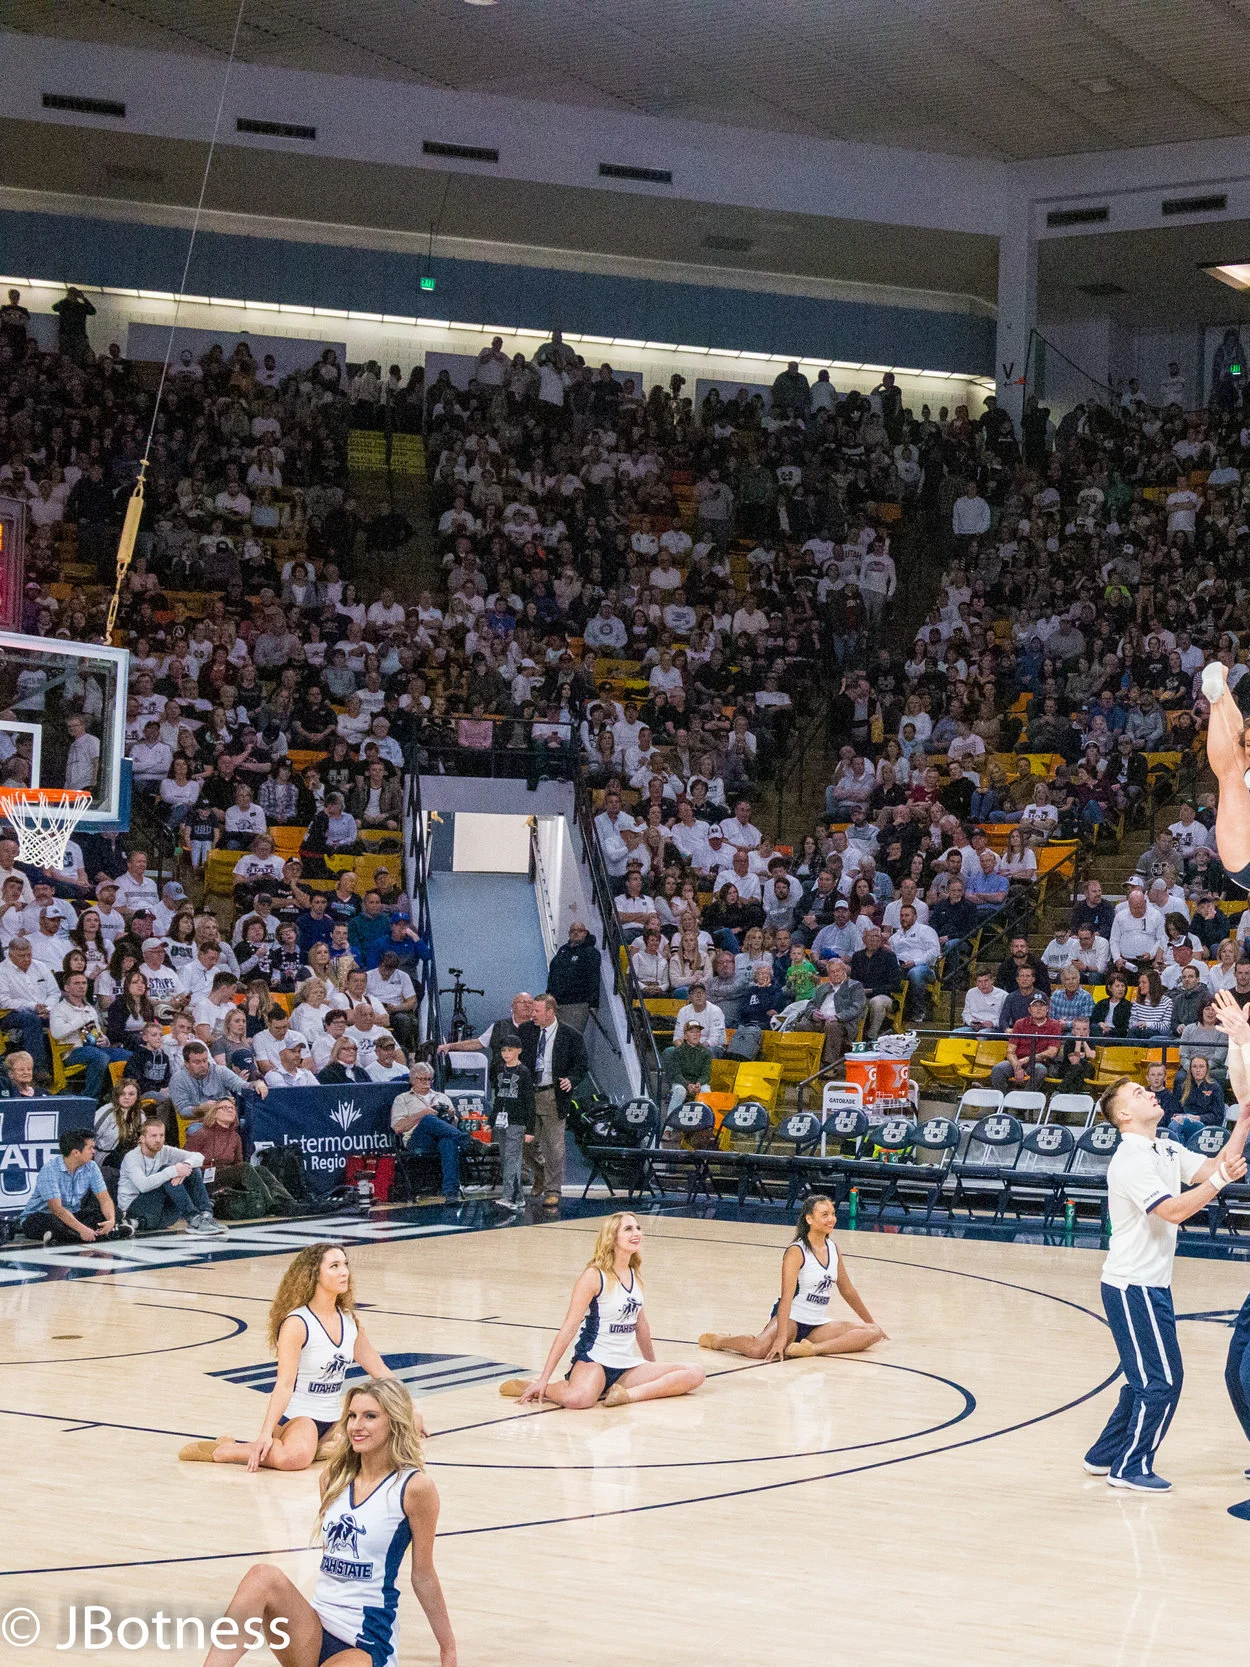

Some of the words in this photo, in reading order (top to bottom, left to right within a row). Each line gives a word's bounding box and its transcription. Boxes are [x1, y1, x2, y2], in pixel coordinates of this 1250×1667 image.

[1002, 363, 1014, 379] V
[828, 1097, 856, 1105] GATORADE
[678, 1111, 703, 1119] STATE
[733, 1111, 757, 1119] STATE
[788, 1121, 811, 1129] STATE
[835, 1118, 857, 1126] STATE
[882, 1128, 907, 1136] STATE
[923, 1127, 949, 1136] STATE
[984, 1124, 1011, 1132] STATE
[283, 1130, 394, 1153] Itermounta
[1036, 1135, 1063, 1143] STATE
[1091, 1133, 1117, 1142] STATE
[1198, 1137, 1223, 1146] STATE
[311, 1154, 346, 1173] Regio
[337, 1560, 373, 1580] STATE
